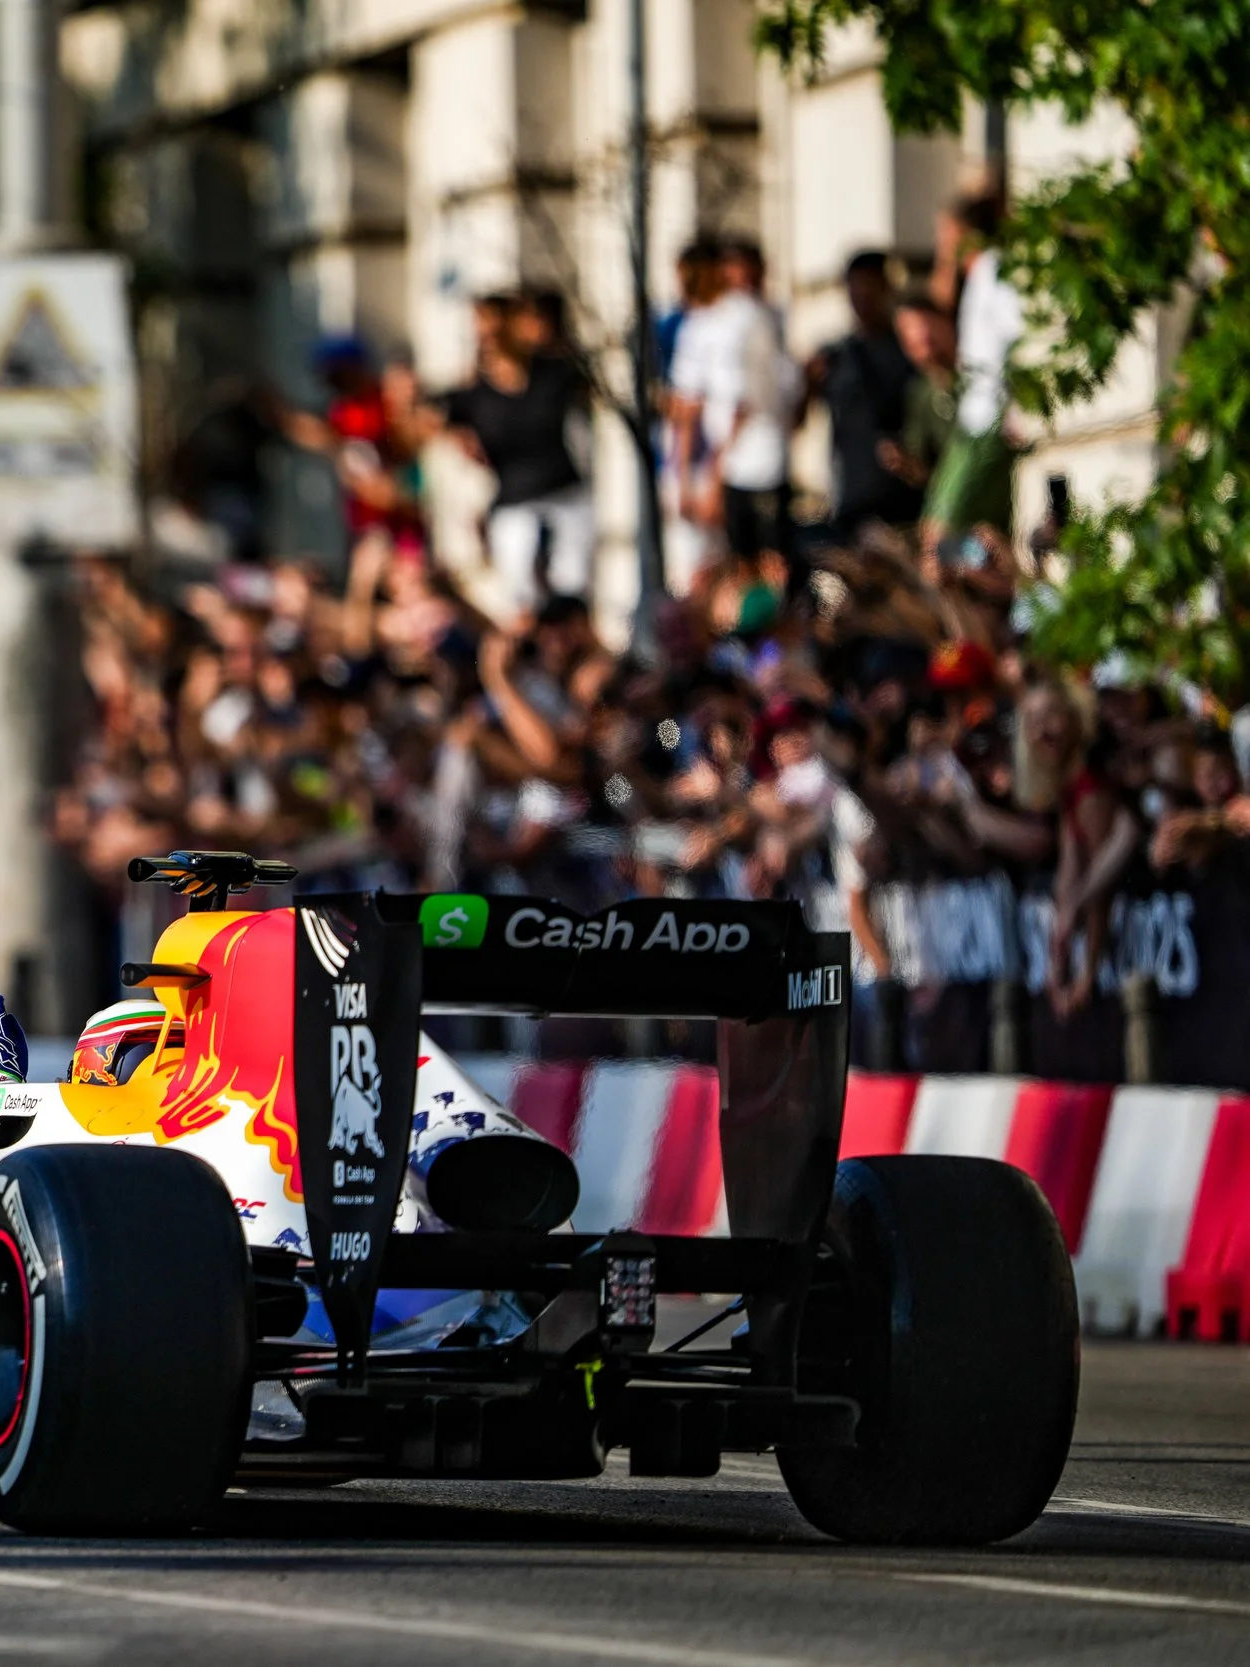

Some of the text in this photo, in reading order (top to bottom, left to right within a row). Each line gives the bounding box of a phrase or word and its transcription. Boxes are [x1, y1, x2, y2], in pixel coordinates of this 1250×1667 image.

[505, 907, 635, 950] Cash
[641, 911, 750, 953] App
[332, 982, 368, 1019] VISA
[787, 967, 840, 1010] Mobil 1
[4, 1094, 38, 1112] Cash App
[346, 1165, 376, 1184] Cash App
[331, 1232, 371, 1260] HUGO
